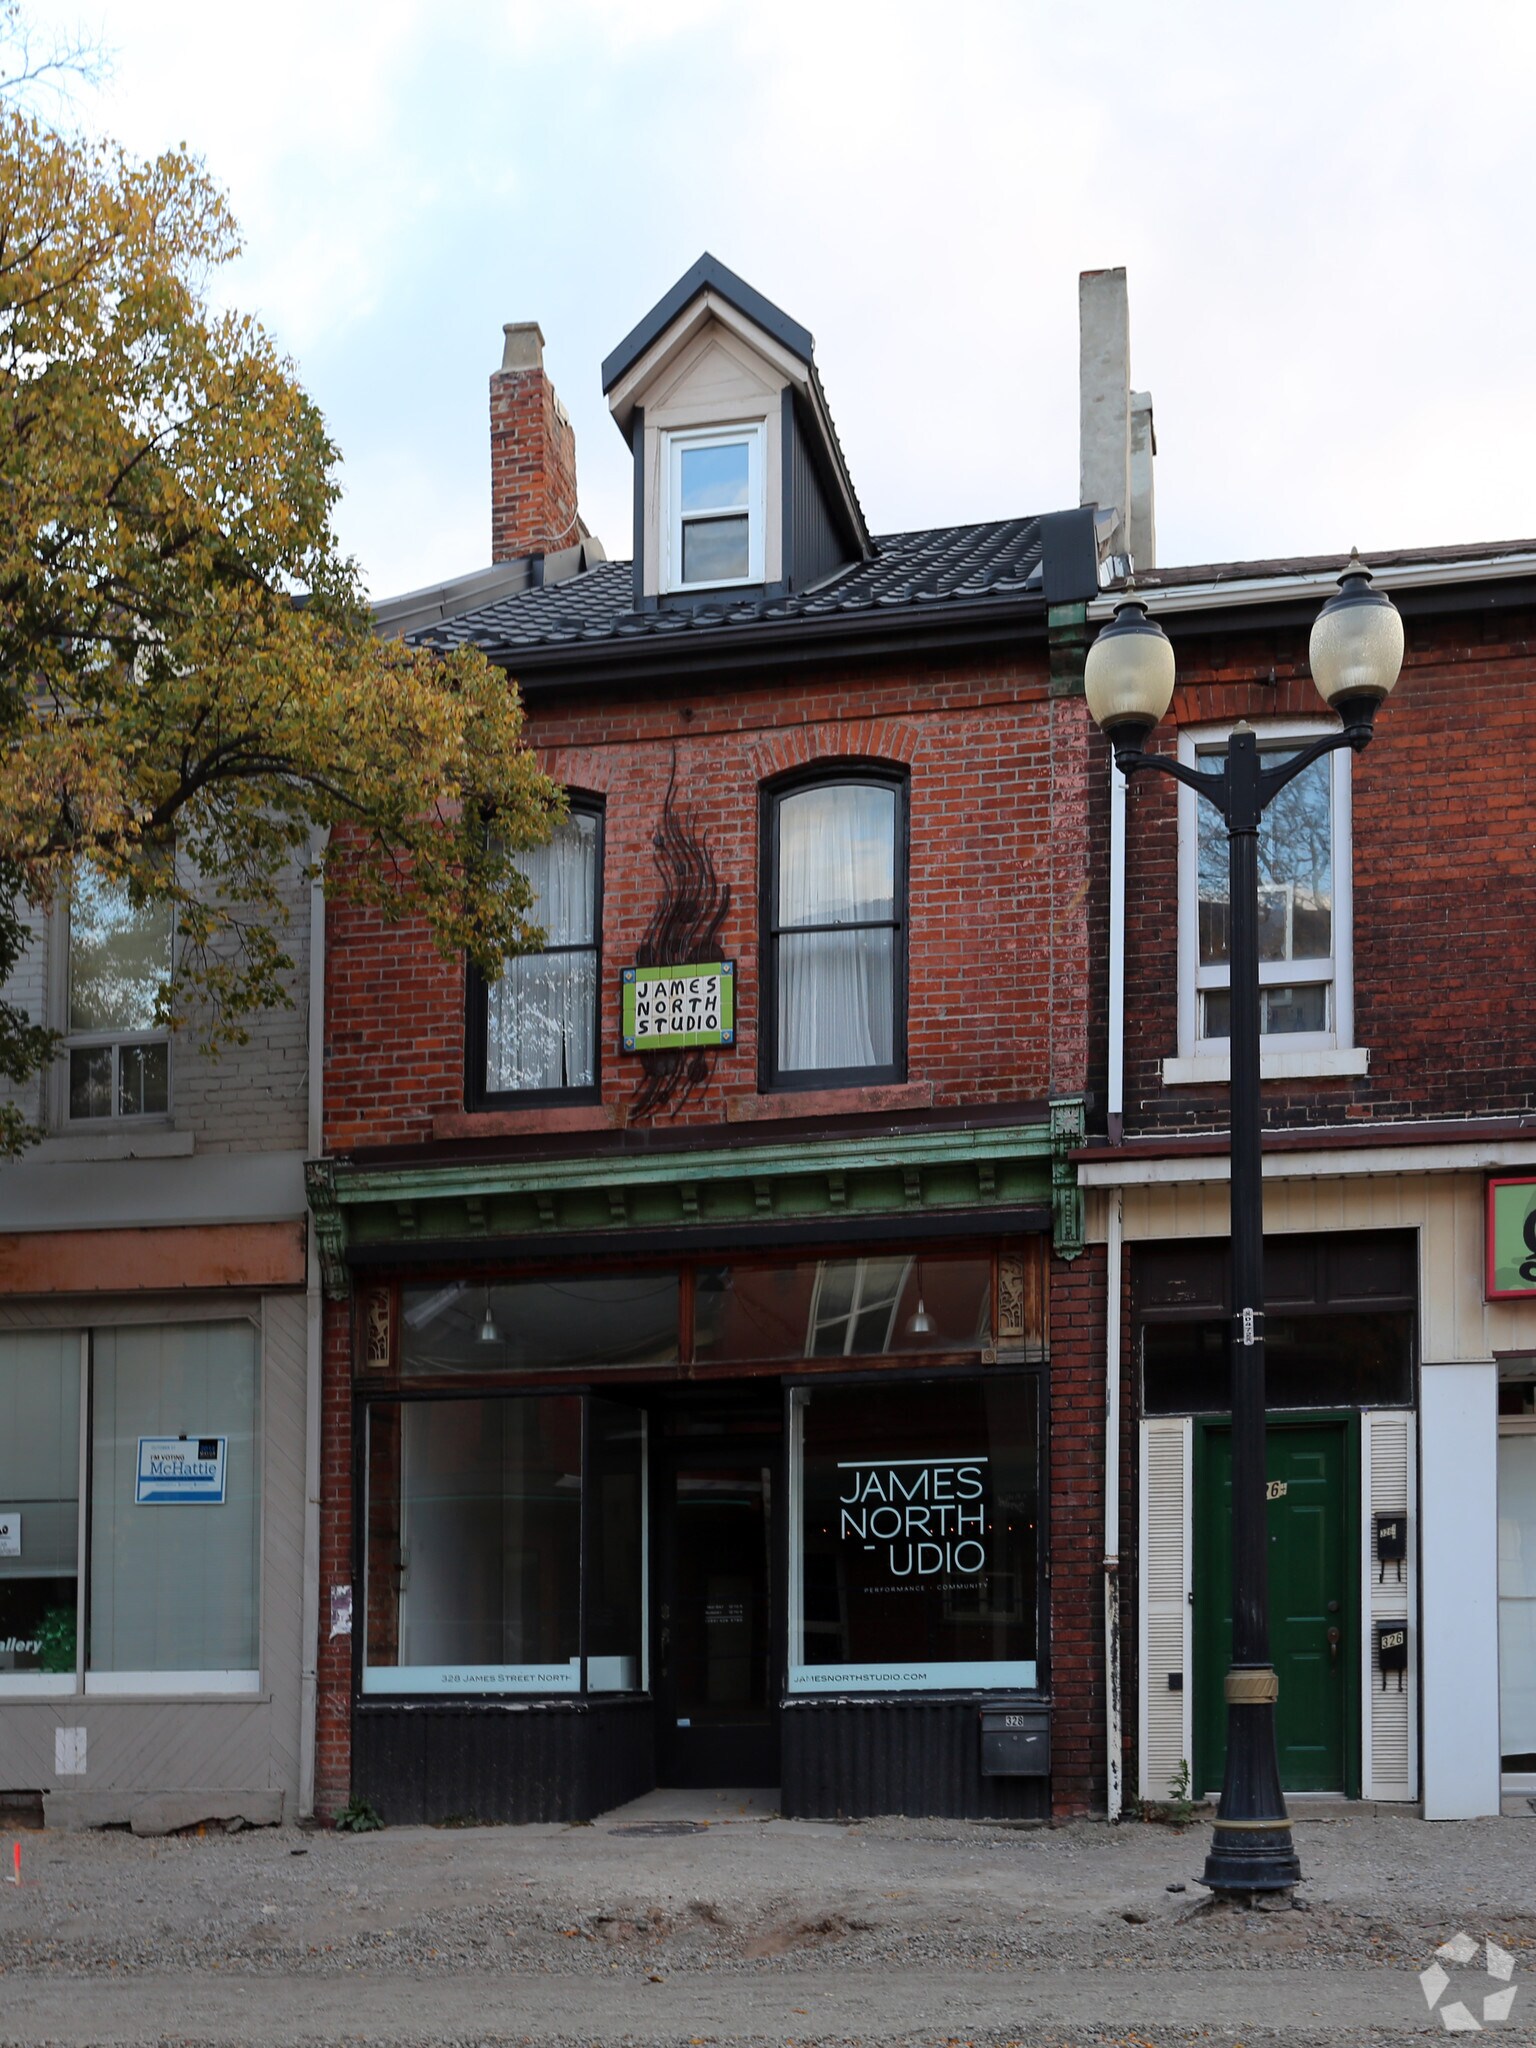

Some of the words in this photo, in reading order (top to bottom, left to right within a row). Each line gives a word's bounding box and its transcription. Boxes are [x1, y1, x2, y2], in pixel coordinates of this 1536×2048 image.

[637, 976, 717, 999] JAMES
[637, 995, 718, 1017] NORTH
[637, 1014, 718, 1035] STUDIO
[150, 1461, 217, 1475] McHattie
[840, 1467, 983, 1504] JAMES
[841, 1504, 985, 1539] NORTH
[863, 1585, 925, 1593] PERFORMANCE
[1382, 1633, 1402, 1648] 326
[441, 1674, 461, 1683] 328
[497, 1674, 535, 1682] STREET
[1006, 1715, 1023, 1726] 328
